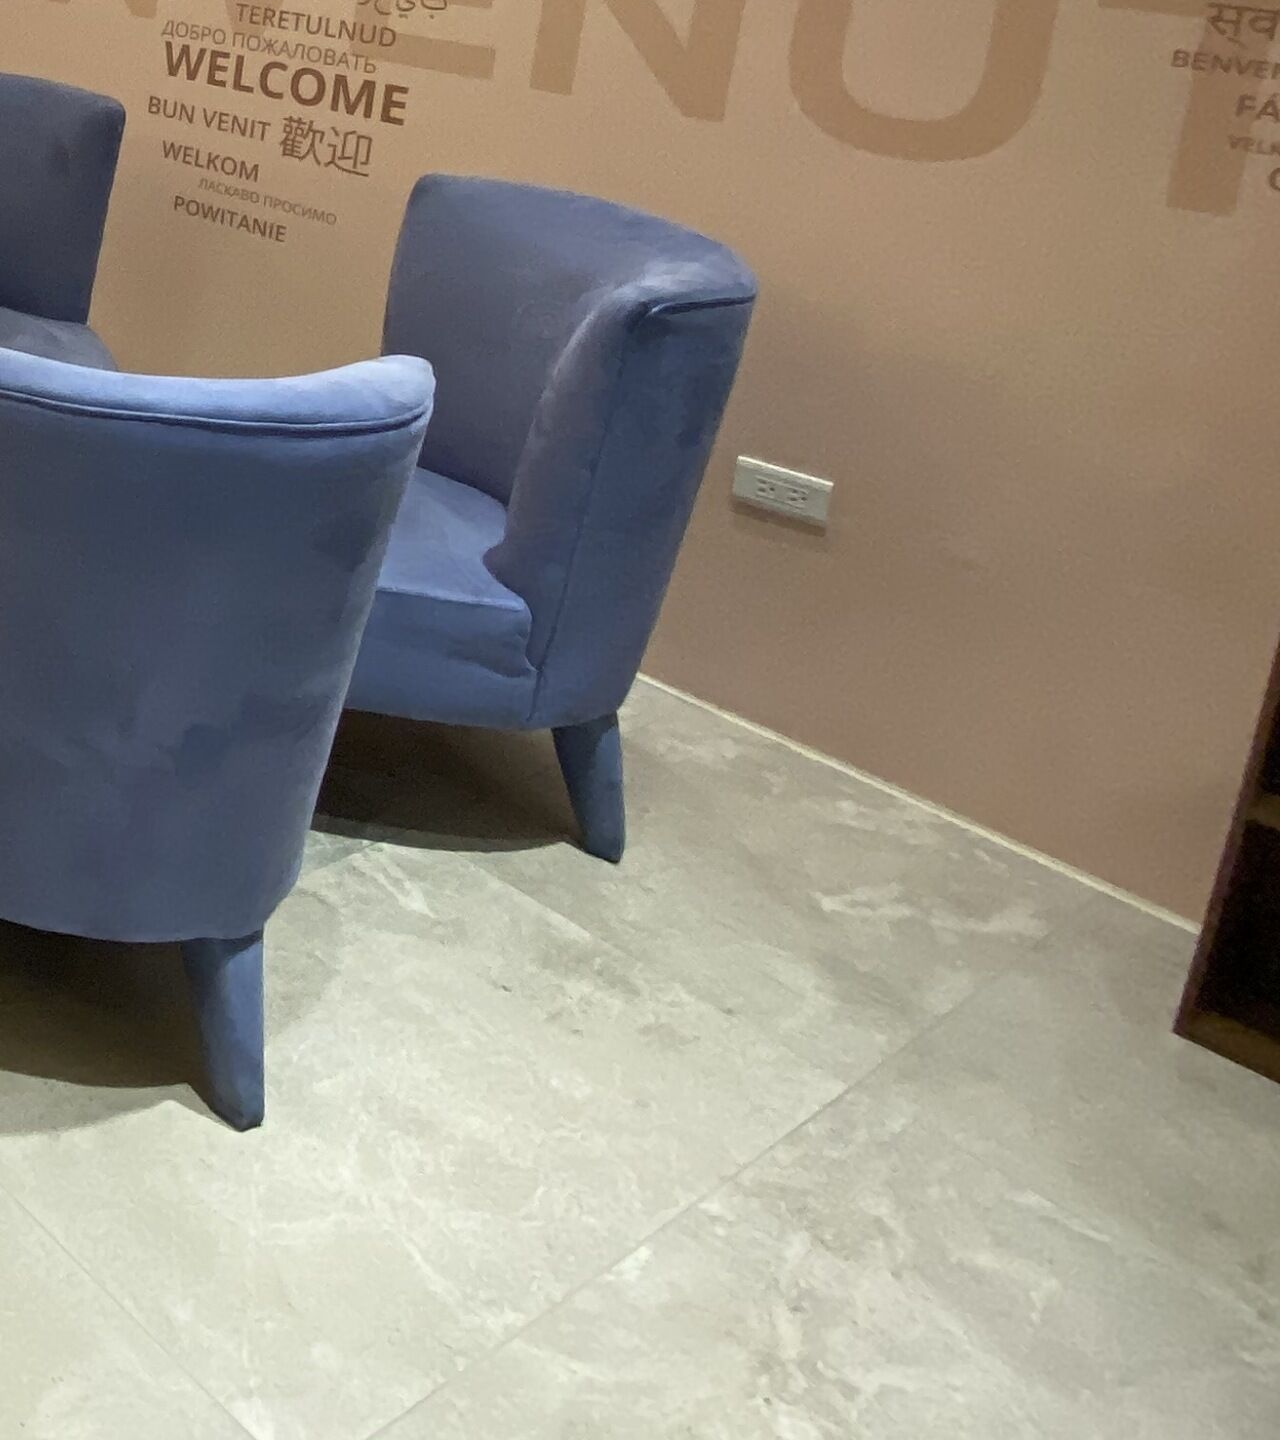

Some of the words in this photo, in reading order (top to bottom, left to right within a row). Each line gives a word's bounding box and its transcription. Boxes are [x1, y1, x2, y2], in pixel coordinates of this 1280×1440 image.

[161, 20, 227, 47] ДОБРО
[232, 30, 378, 75] ПОЖАЛОВАТЬ
[236, 2, 397, 48] TERETULNUD
[164, 41, 410, 127] WELCOME
[147, 95, 196, 125] BUN
[202, 107, 272, 142] VENIT
[161, 139, 260, 184] WELKOM
[173, 195, 287, 243] POWITANIE
